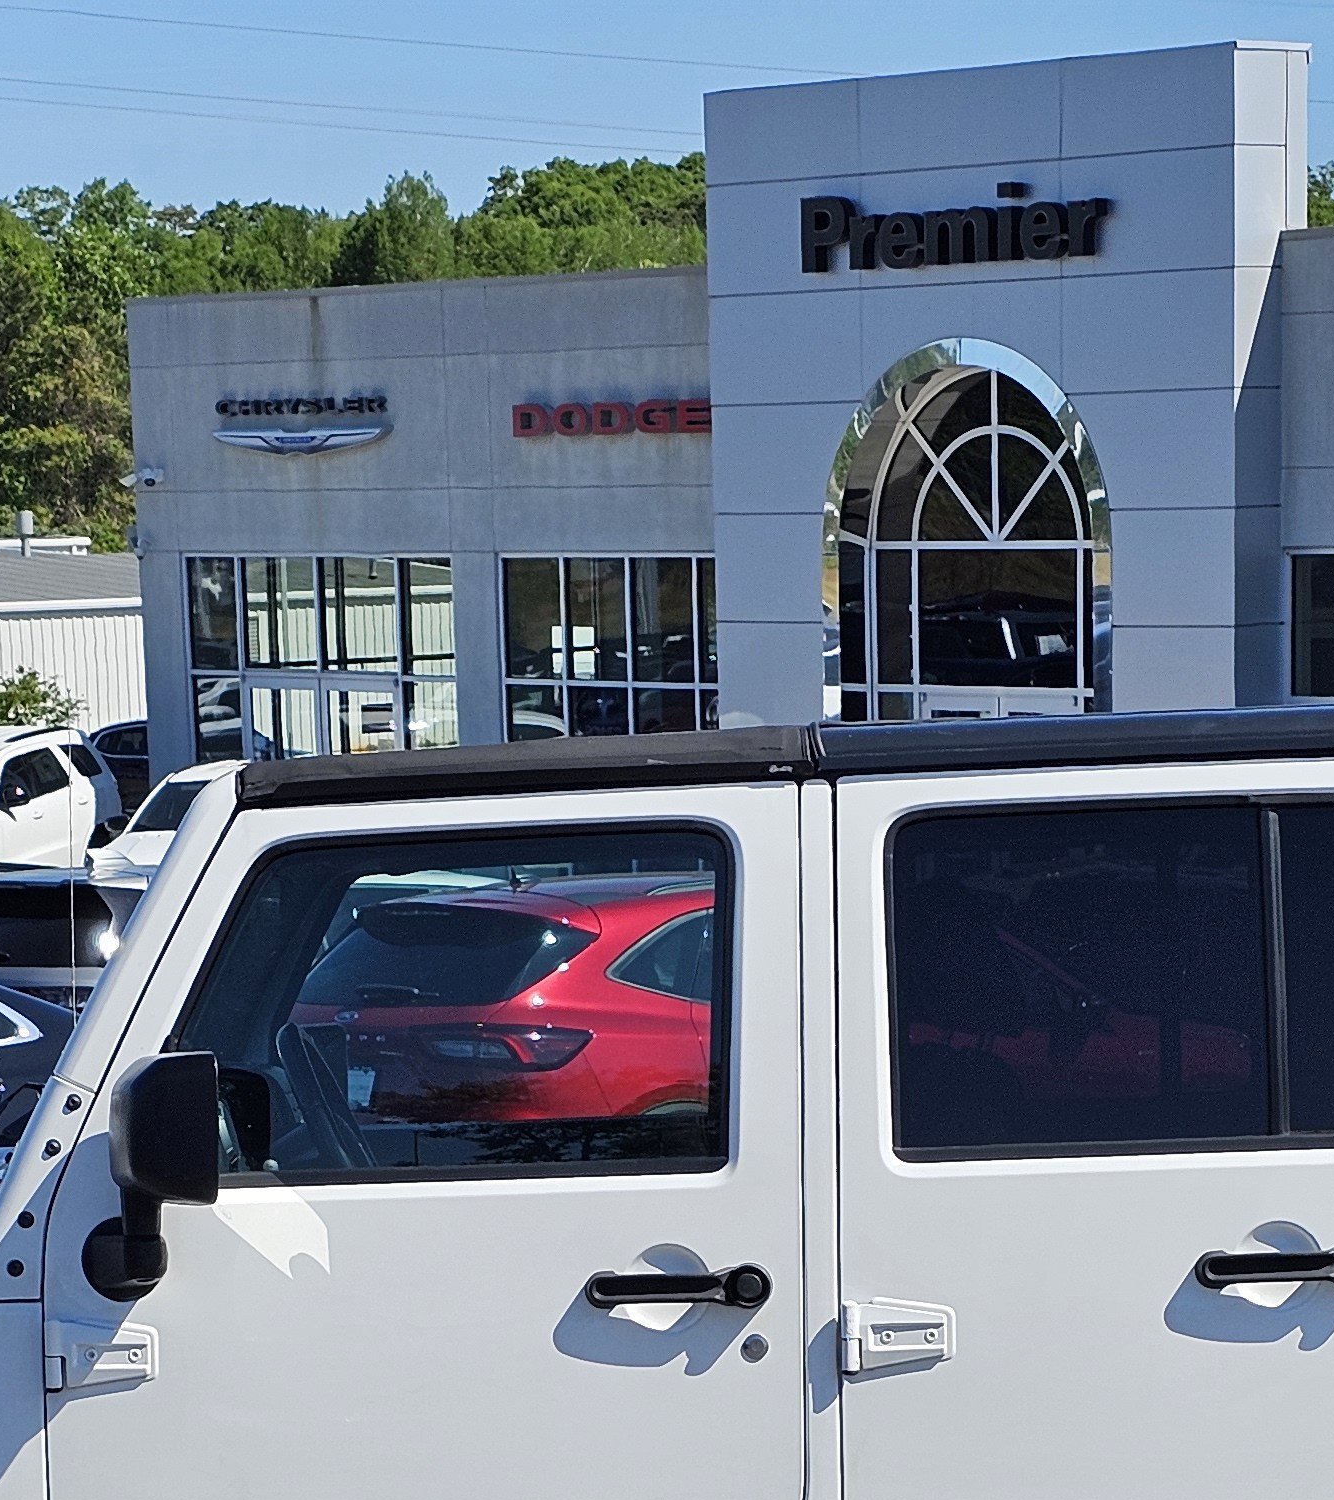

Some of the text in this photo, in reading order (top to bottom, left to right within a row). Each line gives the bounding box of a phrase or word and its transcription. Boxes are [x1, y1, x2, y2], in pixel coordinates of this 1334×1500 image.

[800, 182, 1108, 274] Premier
[215, 393, 389, 418] CHRYSLER
[513, 399, 711, 438] DODGE
